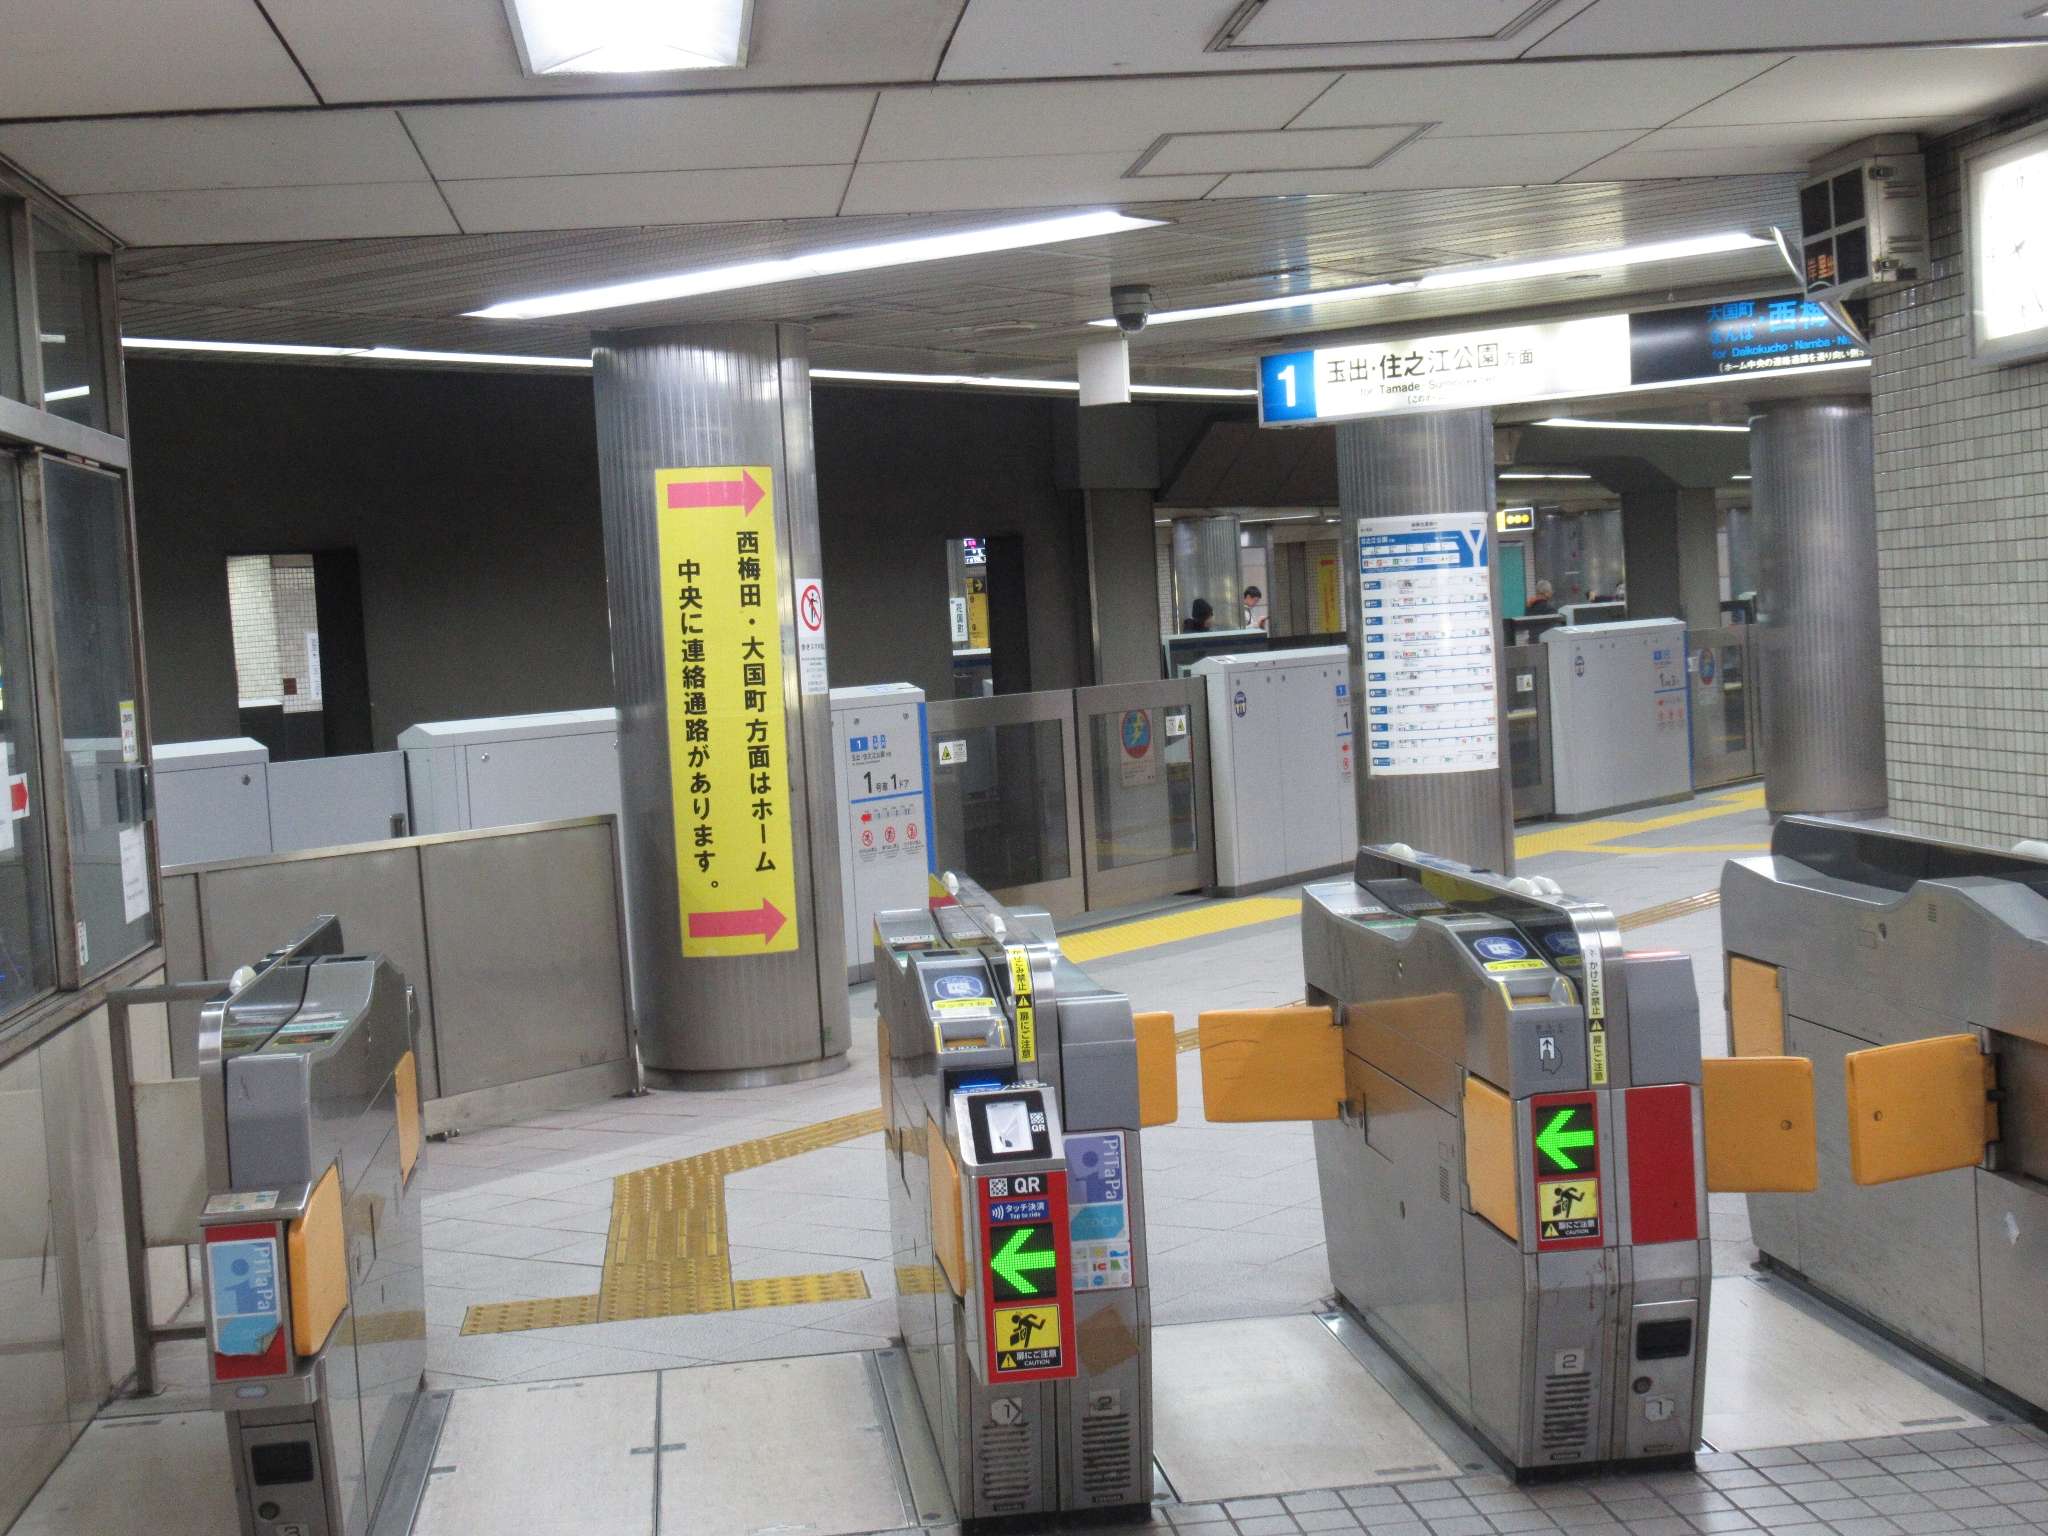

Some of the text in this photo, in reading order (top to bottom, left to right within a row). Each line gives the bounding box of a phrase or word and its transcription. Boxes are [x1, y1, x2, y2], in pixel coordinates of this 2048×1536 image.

[1277, 364, 1297, 408] 1
[1379, 381, 1421, 394] Tamade
[1460, 528, 1487, 568] Y
[736, 530, 777, 873] 西梅田・大国町方面はホーム
[678, 558, 719, 889] 中央に連絡通路があります。
[1031, 1123, 1046, 1132] QR
[1014, 1176, 1041, 1194] QR
[1102, 1136, 1122, 1200] PiTaPa
[1005, 1202, 1045, 1213] タッチ決済
[254, 1246, 275, 1311] PiTaPa
[1023, 1358, 1051, 1367] CAUTION
